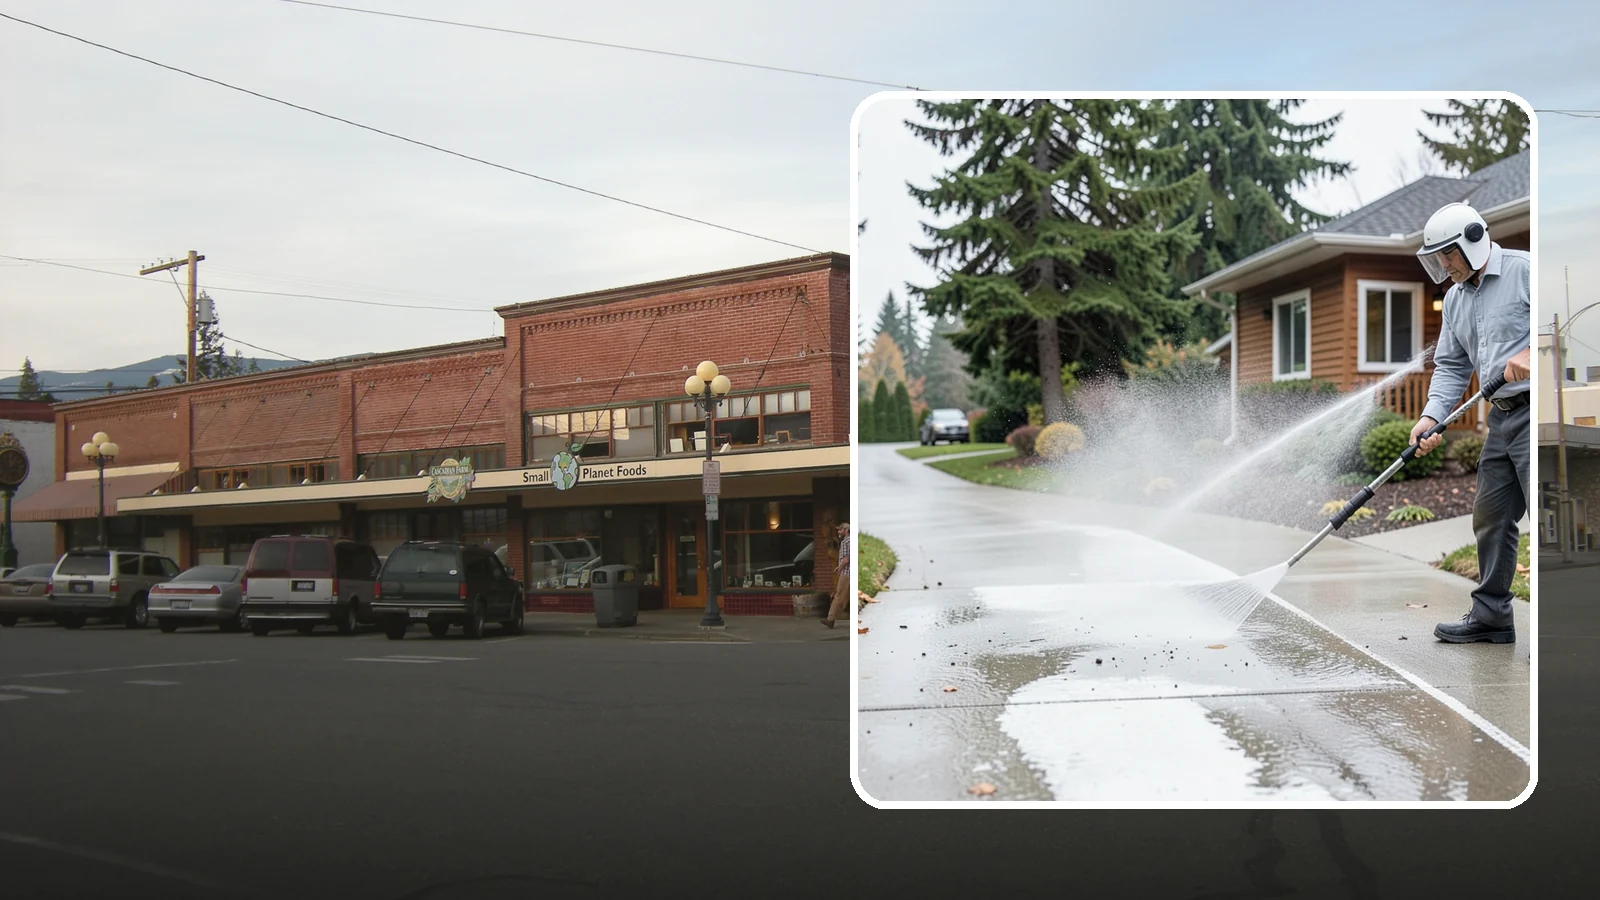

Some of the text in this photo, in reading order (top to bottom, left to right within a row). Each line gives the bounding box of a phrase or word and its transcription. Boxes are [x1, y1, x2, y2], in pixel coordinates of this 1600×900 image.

[523, 464, 647, 483] Small Planet Foods
